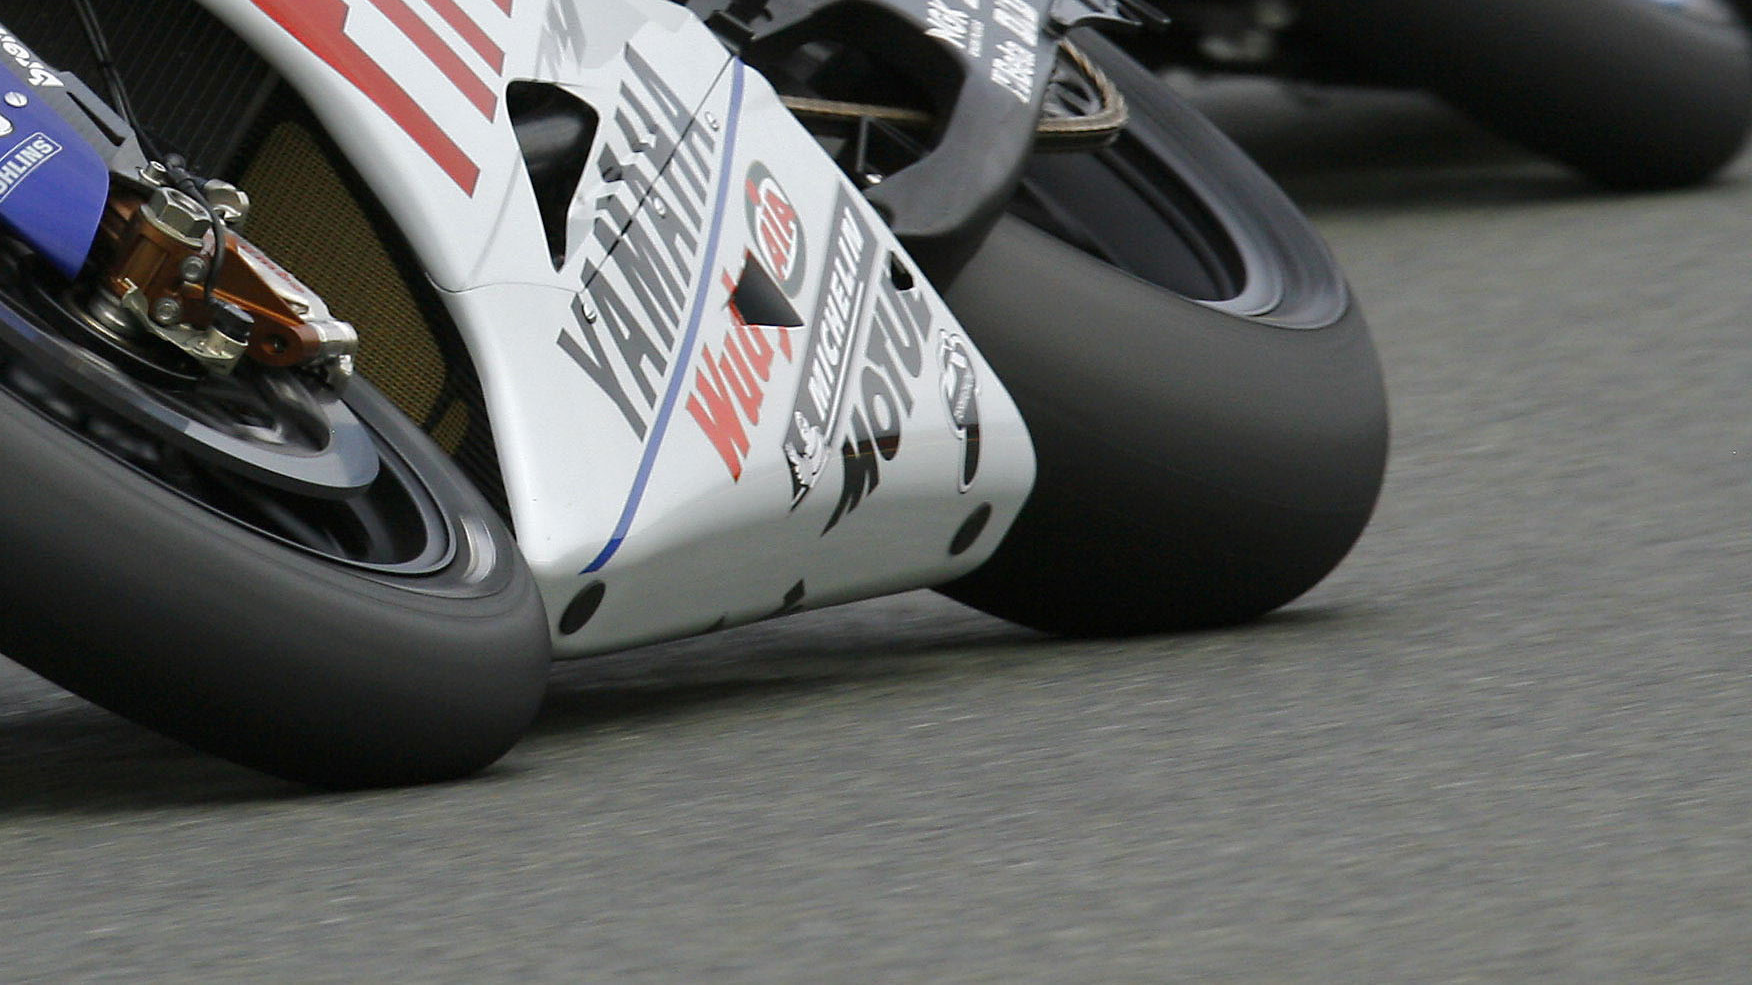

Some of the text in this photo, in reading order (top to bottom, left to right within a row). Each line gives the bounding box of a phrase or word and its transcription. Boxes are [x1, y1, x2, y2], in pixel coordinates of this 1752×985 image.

[556, 41, 717, 444] YAMAHA
[808, 205, 865, 421] MICHELIN
[821, 250, 932, 537] MOTUL
